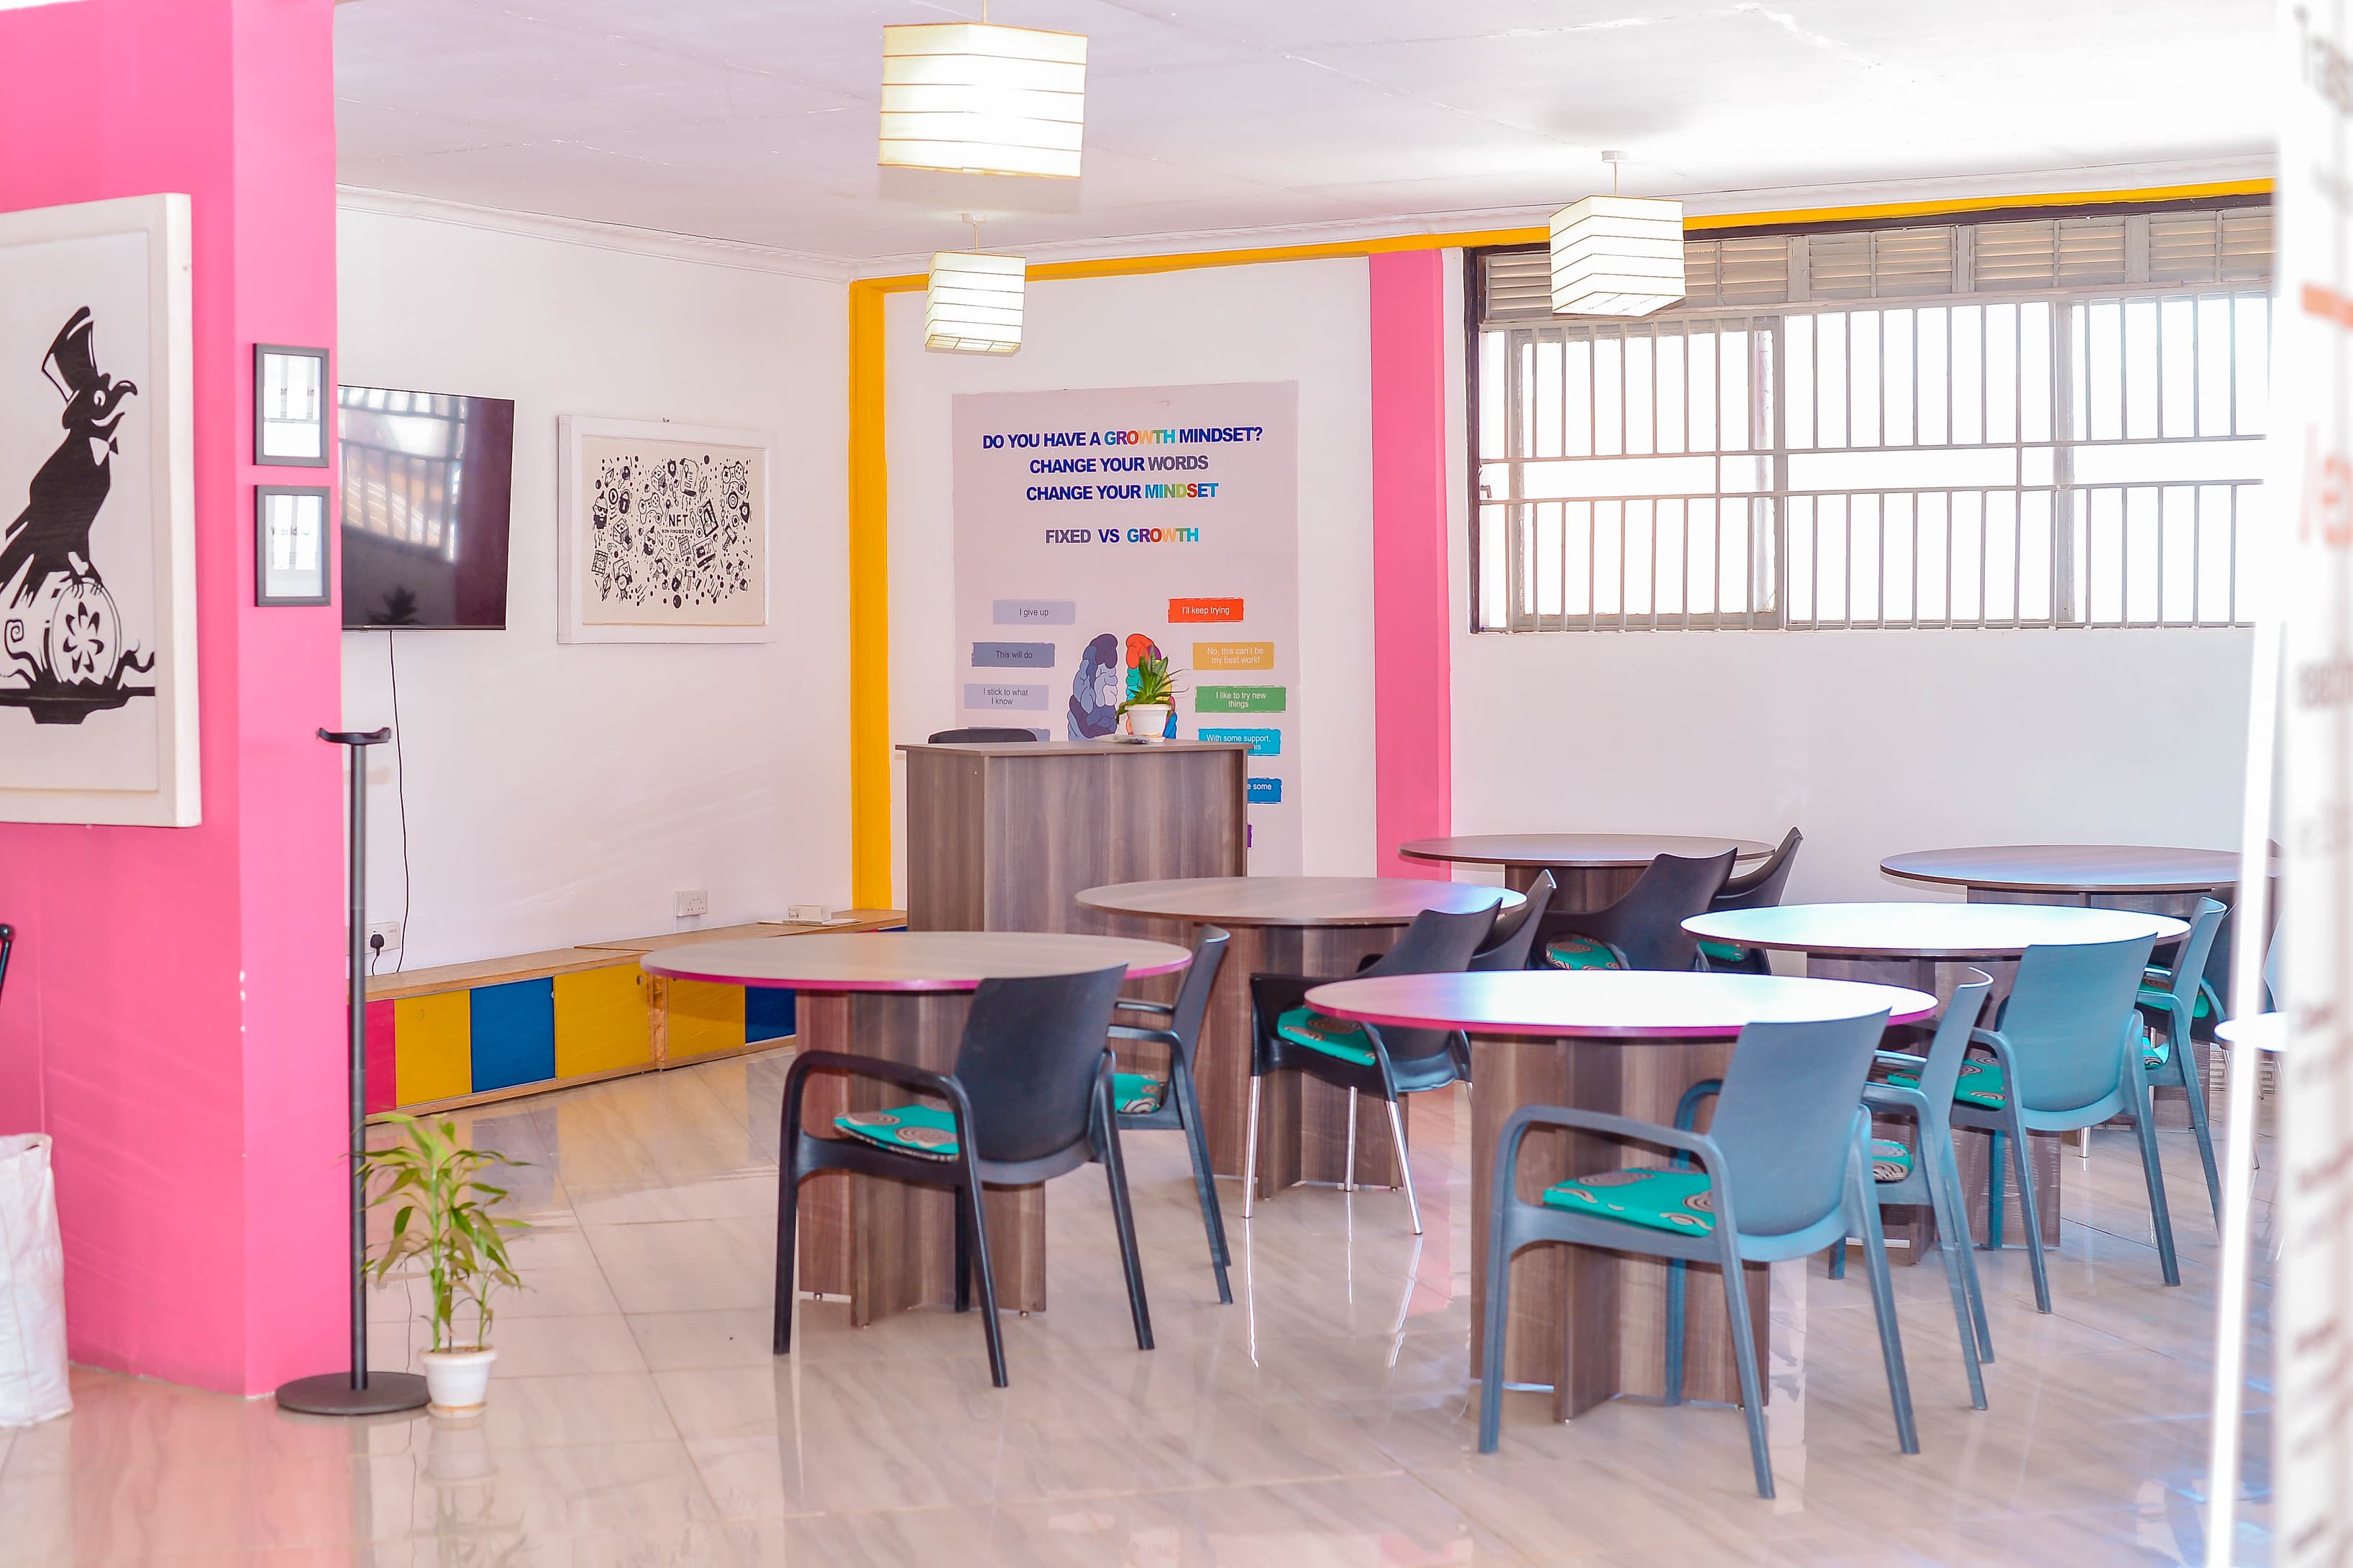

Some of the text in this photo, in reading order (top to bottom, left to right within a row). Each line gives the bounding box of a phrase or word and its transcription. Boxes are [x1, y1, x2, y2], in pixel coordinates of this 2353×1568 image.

[982, 426, 1263, 449] DO YOU HAVE A GROWTH MINDSET?
[1029, 455, 1209, 474] CHANGE YOUR WORDS
[1026, 482, 1219, 501] CHANGE YOUR MINDSET
[668, 513, 688, 527] NFT
[1046, 527, 1200, 544] FIXED VS GROWTH
[1023, 608, 1038, 618] give
[1040, 610, 1049, 618] up
[1182, 606, 1230, 615] I'll keep trying
[995, 650, 1010, 659] This
[1207, 647, 1219, 656] No,
[1254, 646, 1264, 655] be
[1211, 657, 1222, 666] my
[1241, 655, 1260, 664] work!
[1220, 691, 1232, 700] like
[1241, 692, 1251, 701] try
[1228, 700, 1249, 709] things
[1206, 734, 1222, 743] With
